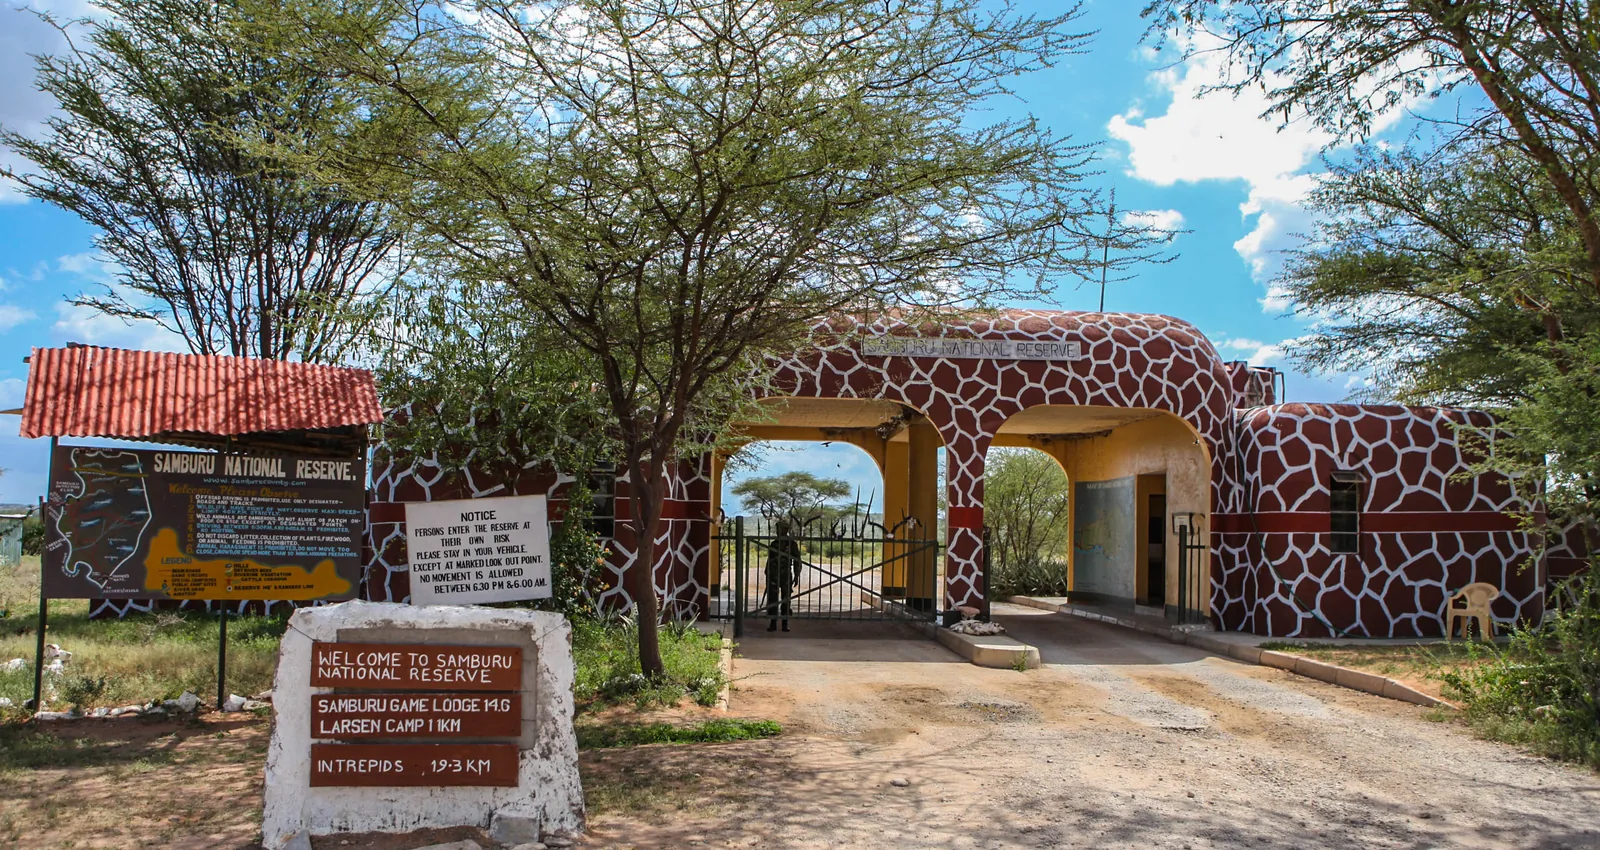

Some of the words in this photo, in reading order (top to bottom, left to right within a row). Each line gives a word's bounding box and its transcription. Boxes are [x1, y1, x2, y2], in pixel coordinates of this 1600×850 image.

[867, 339, 935, 355] SABURU
[941, 340, 1010, 357] NATIONAL
[1016, 342, 1075, 358] RESERVE
[154, 453, 216, 474] SAMBURU
[224, 456, 286, 478] NATIONAL
[296, 460, 356, 480] RESERVE.
[220, 485, 258, 496] Please
[460, 510, 496, 522] NOTICE
[415, 527, 444, 537] PERSONS
[448, 526, 470, 535] ENTER
[474, 524, 487, 533] THE
[490, 522, 519, 532] RESERVE
[441, 538, 462, 547] THEIR
[469, 536, 484, 545] OWN
[494, 534, 510, 543] RISK
[416, 551, 441, 560] PLEASE
[444, 550, 460, 558] STAY
[463, 549, 470, 557] IN
[474, 546, 493, 556] YOUR
[413, 562, 441, 572] EXCEPT
[445, 561, 454, 570] AT
[456, 559, 484, 569] MARKED
[485, 558, 502, 567] LOOK
[505, 557, 519, 565] OUT
[521, 555, 543, 565] POINT.
[420, 574, 430, 583] NO
[432, 572, 471, 582] MOVEMENT
[475, 571, 483, 579] IS
[488, 568, 523, 578] ALLOWED
[434, 583, 471, 594] BETWEEN
[473, 582, 489, 591] 6.30
[492, 581, 504, 590] PM
[318, 650, 402, 667] WELCOME
[408, 652, 429, 667] TO
[436, 654, 512, 669] SAMBURU
[318, 666, 401, 681] NATIONAL
[409, 667, 492, 684] RESERVE
[318, 699, 387, 713] SAMBURU
[390, 698, 429, 712] GAME
[432, 698, 481, 712] LODGE
[320, 719, 381, 734] LARSEN
[385, 718, 424, 733] CAMP
[318, 759, 404, 773] INTREPIDS
[466, 759, 491, 776] KM
